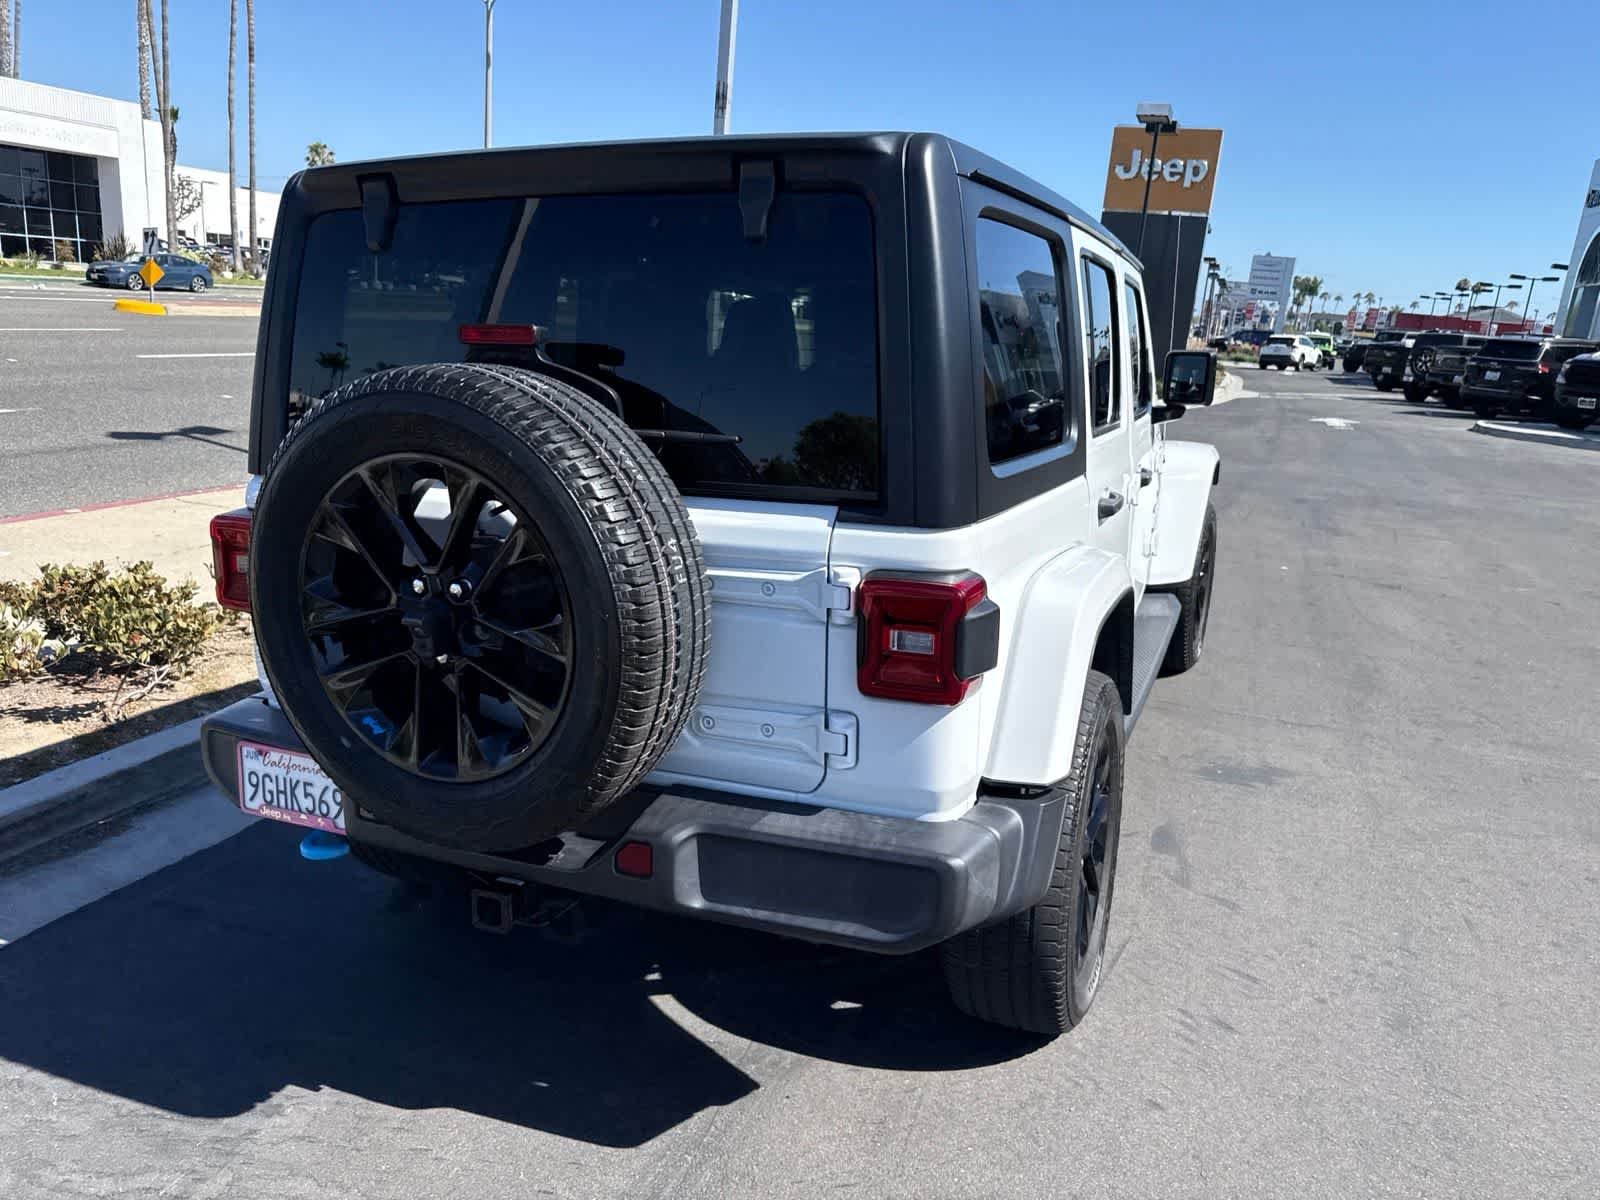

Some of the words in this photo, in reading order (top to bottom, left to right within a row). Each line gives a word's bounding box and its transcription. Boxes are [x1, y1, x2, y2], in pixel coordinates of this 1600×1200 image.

[1114, 149, 1209, 188] Jeep
[262, 752, 329, 780] California
[247, 770, 344, 820] 9GHK569
[259, 805, 282, 820] Jeep
